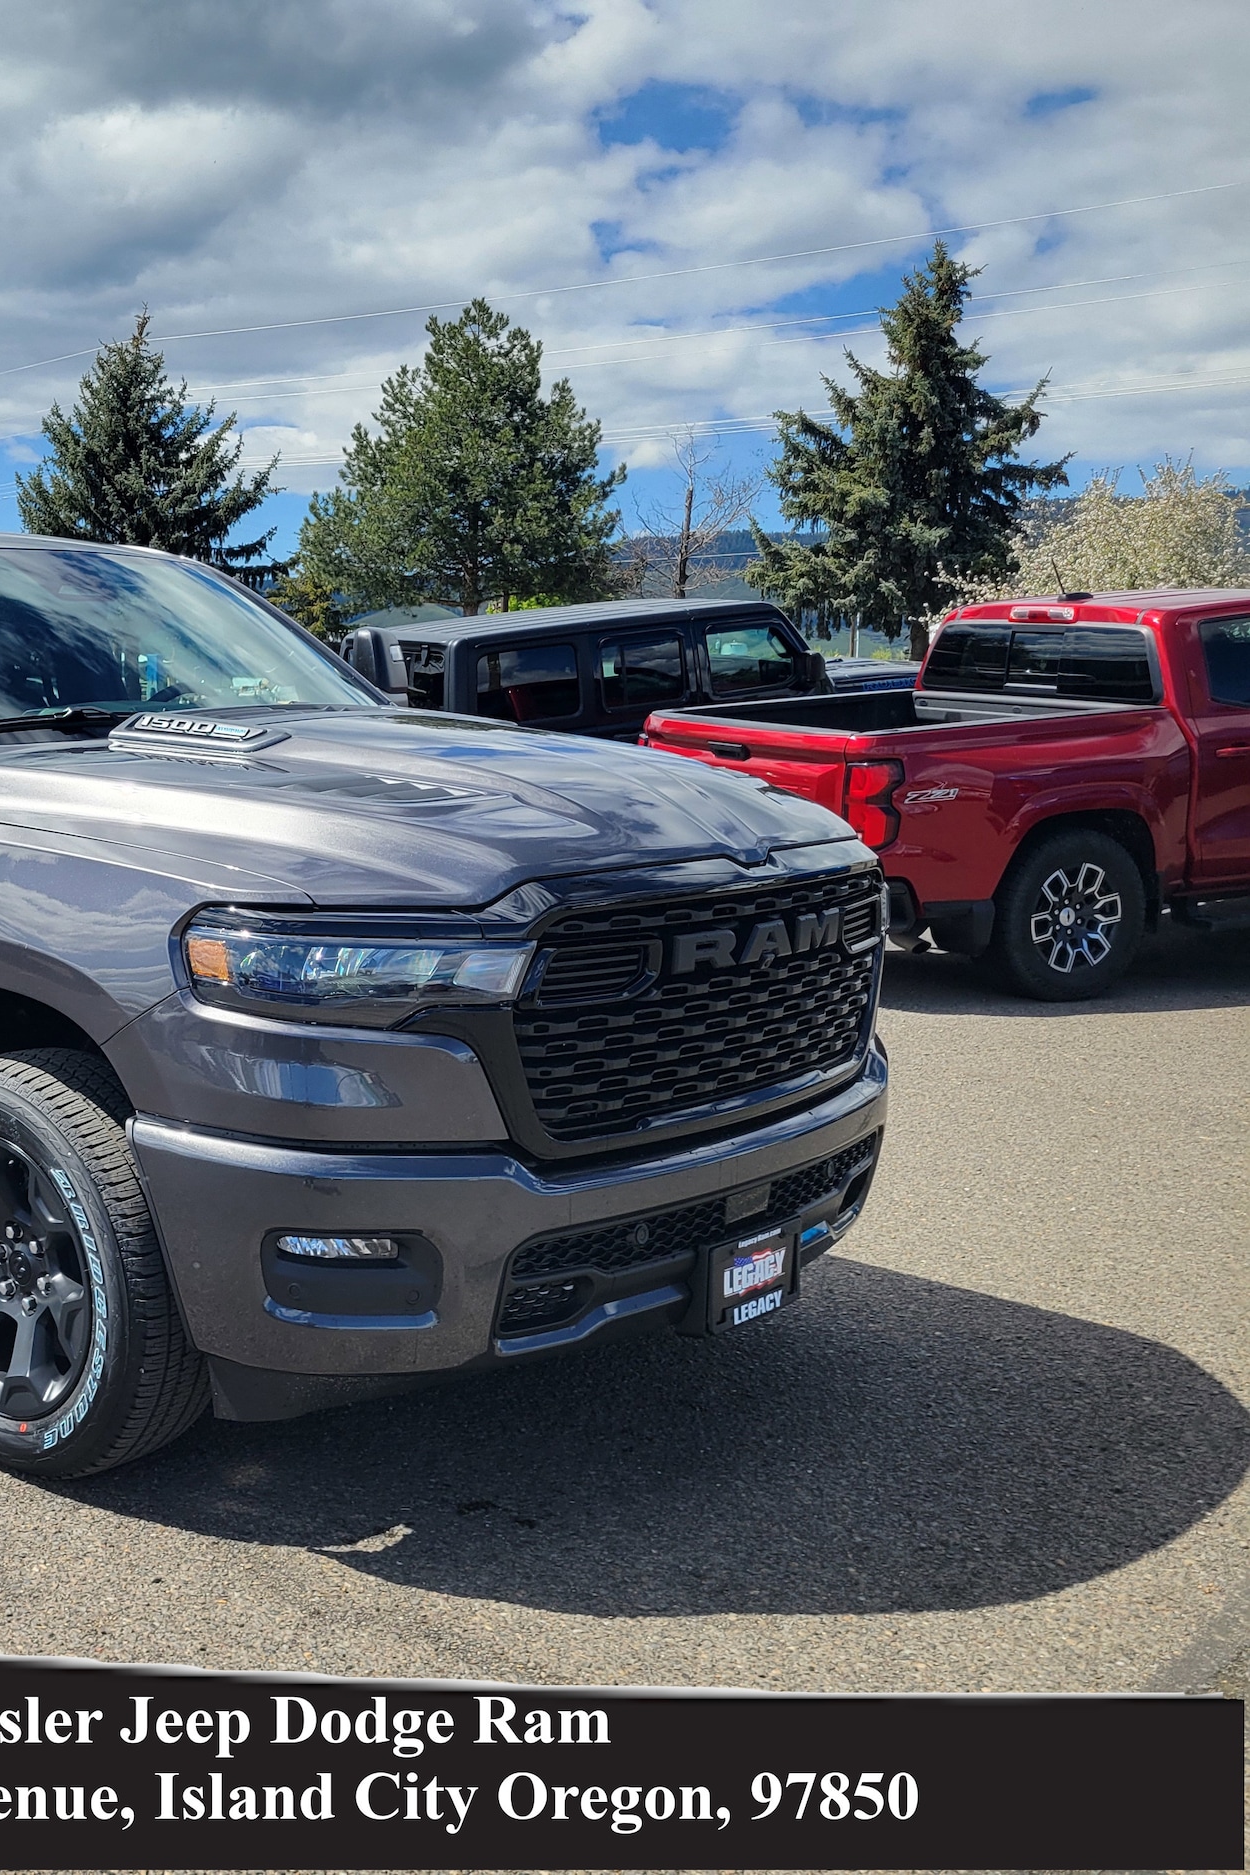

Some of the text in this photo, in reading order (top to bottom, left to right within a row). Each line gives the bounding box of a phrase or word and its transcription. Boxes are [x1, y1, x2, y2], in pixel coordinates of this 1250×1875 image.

[140, 715, 216, 734] 1500
[671, 908, 840, 976] RAM
[723, 1249, 786, 1297] LEGACY
[43, 1167, 108, 1450] BRIDGESTONE
[733, 1289, 783, 1326] LEGACY
